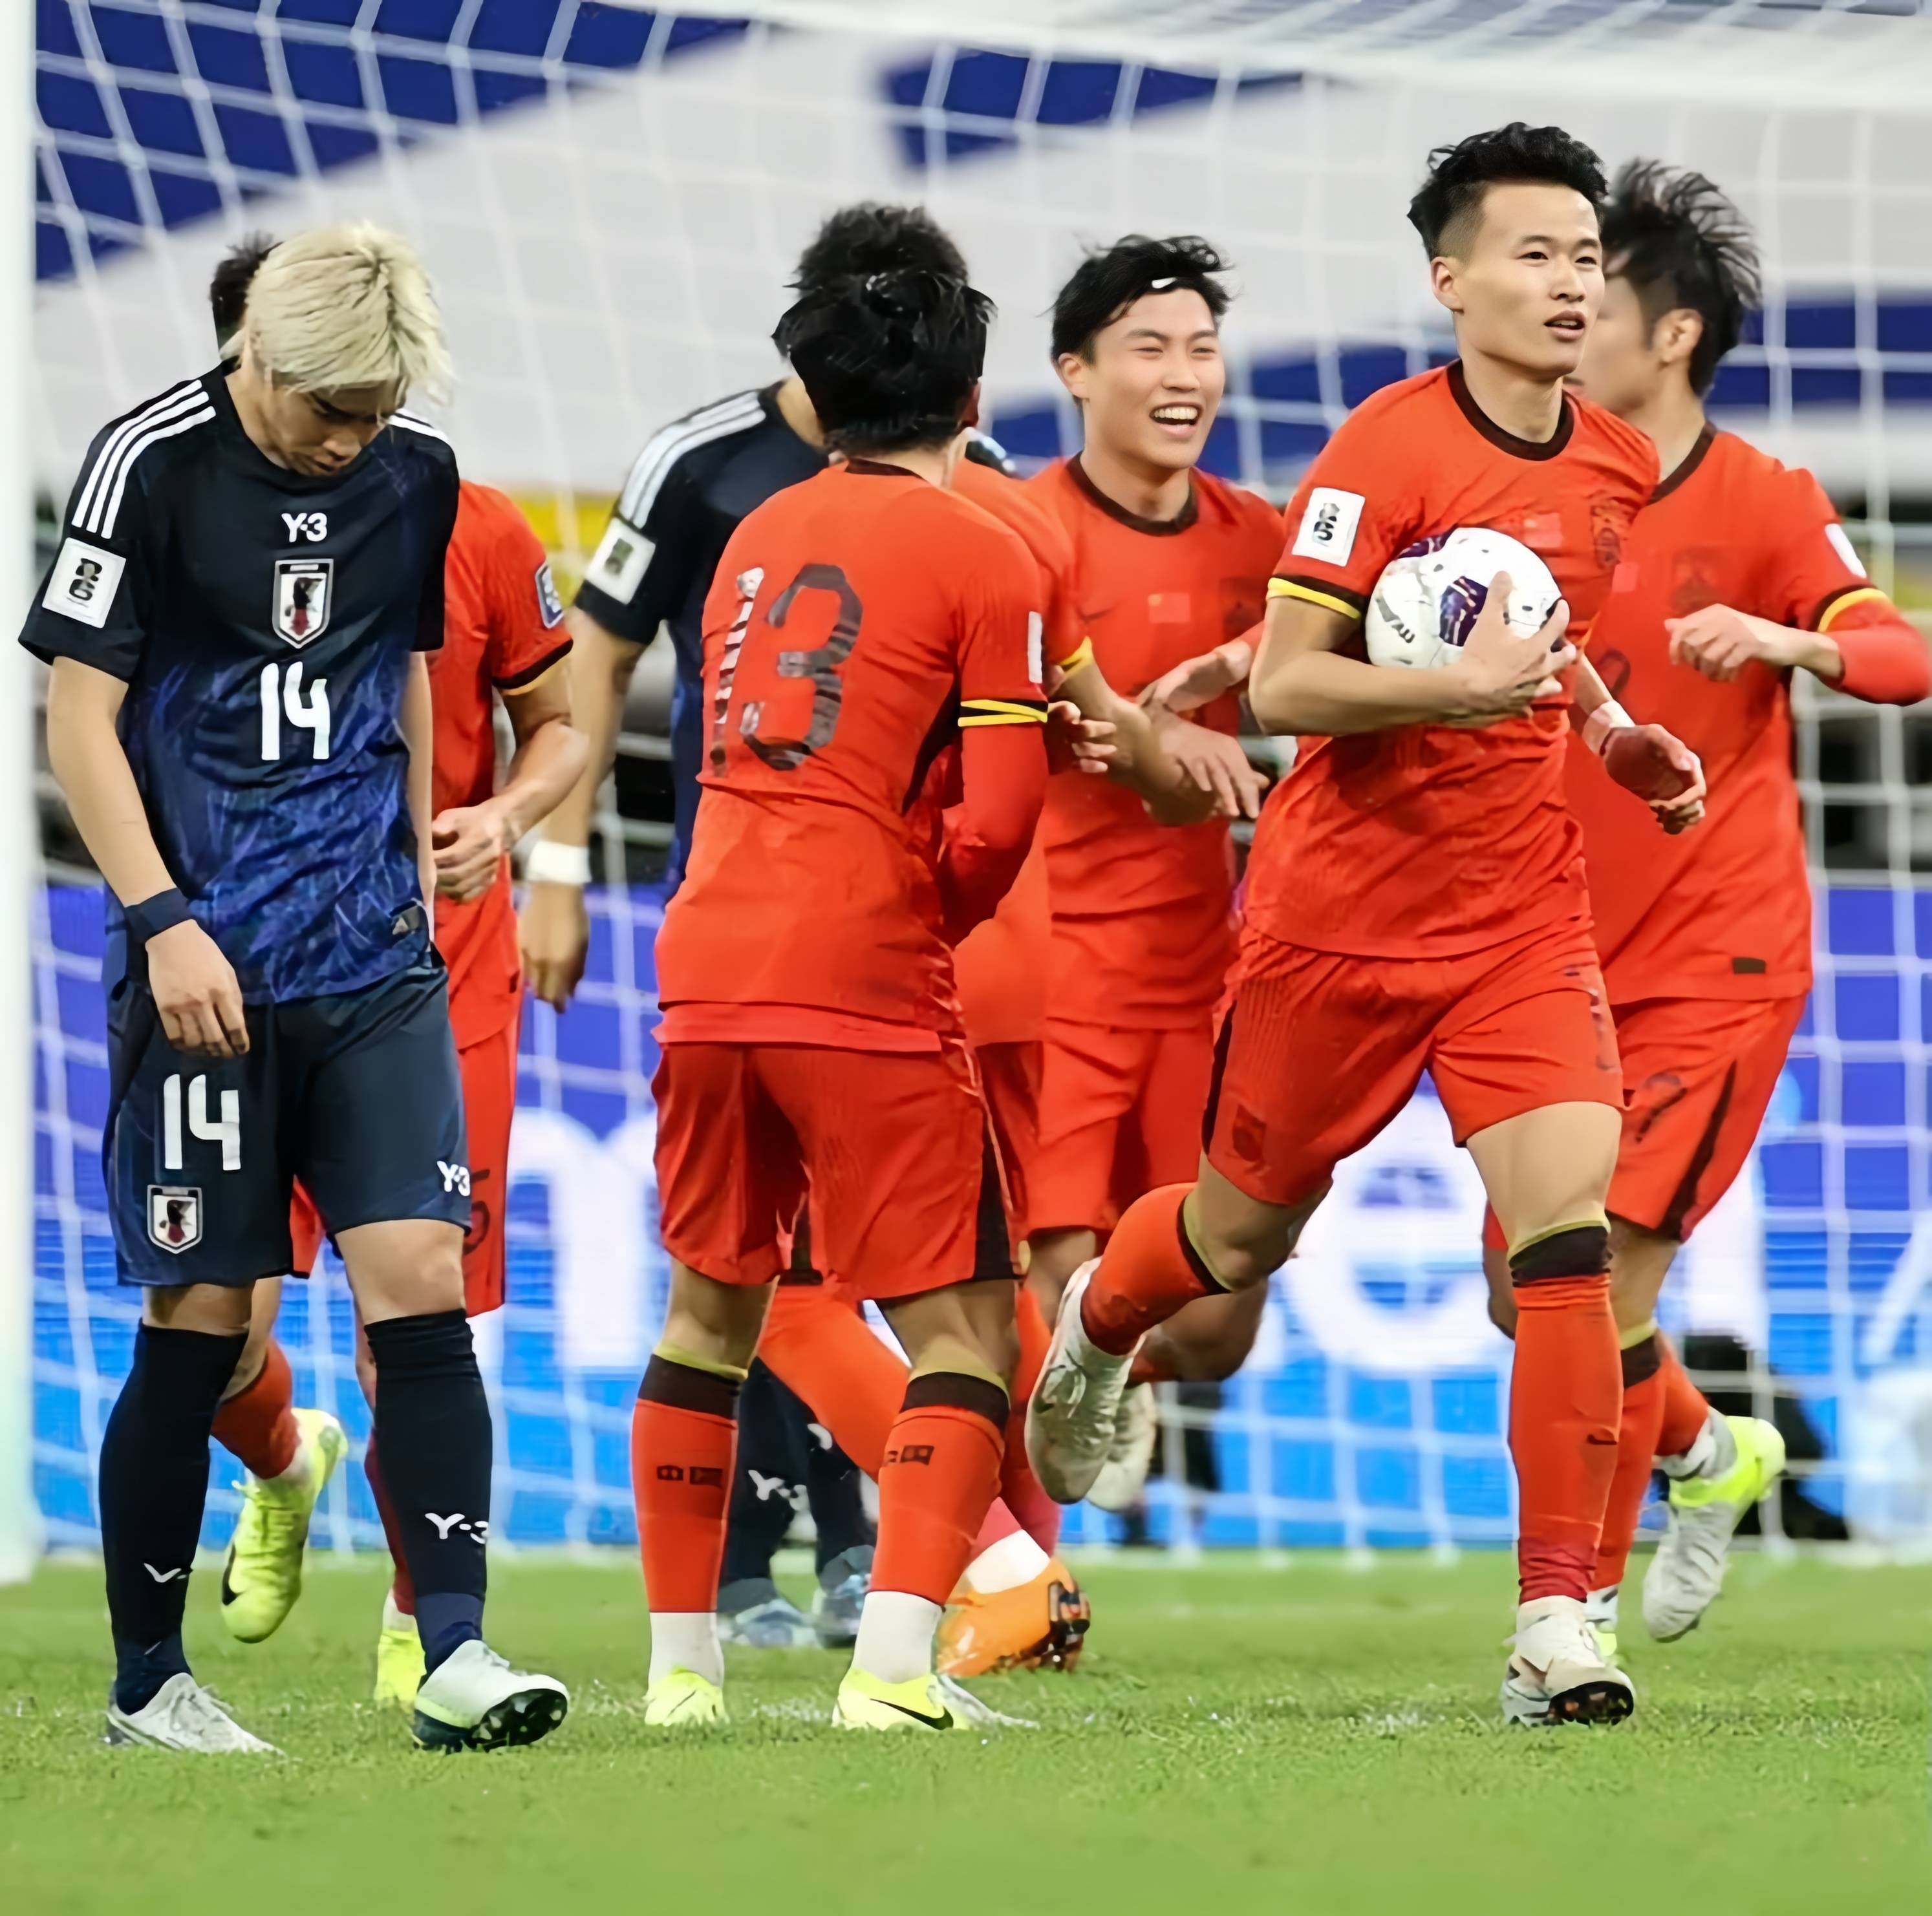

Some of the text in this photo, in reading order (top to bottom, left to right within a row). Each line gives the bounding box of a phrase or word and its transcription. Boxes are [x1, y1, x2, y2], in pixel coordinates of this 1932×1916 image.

[282, 513, 328, 542] Y-3
[261, 661, 330, 761] 14
[709, 564, 863, 778] 13
[164, 1073, 241, 1171] 14
